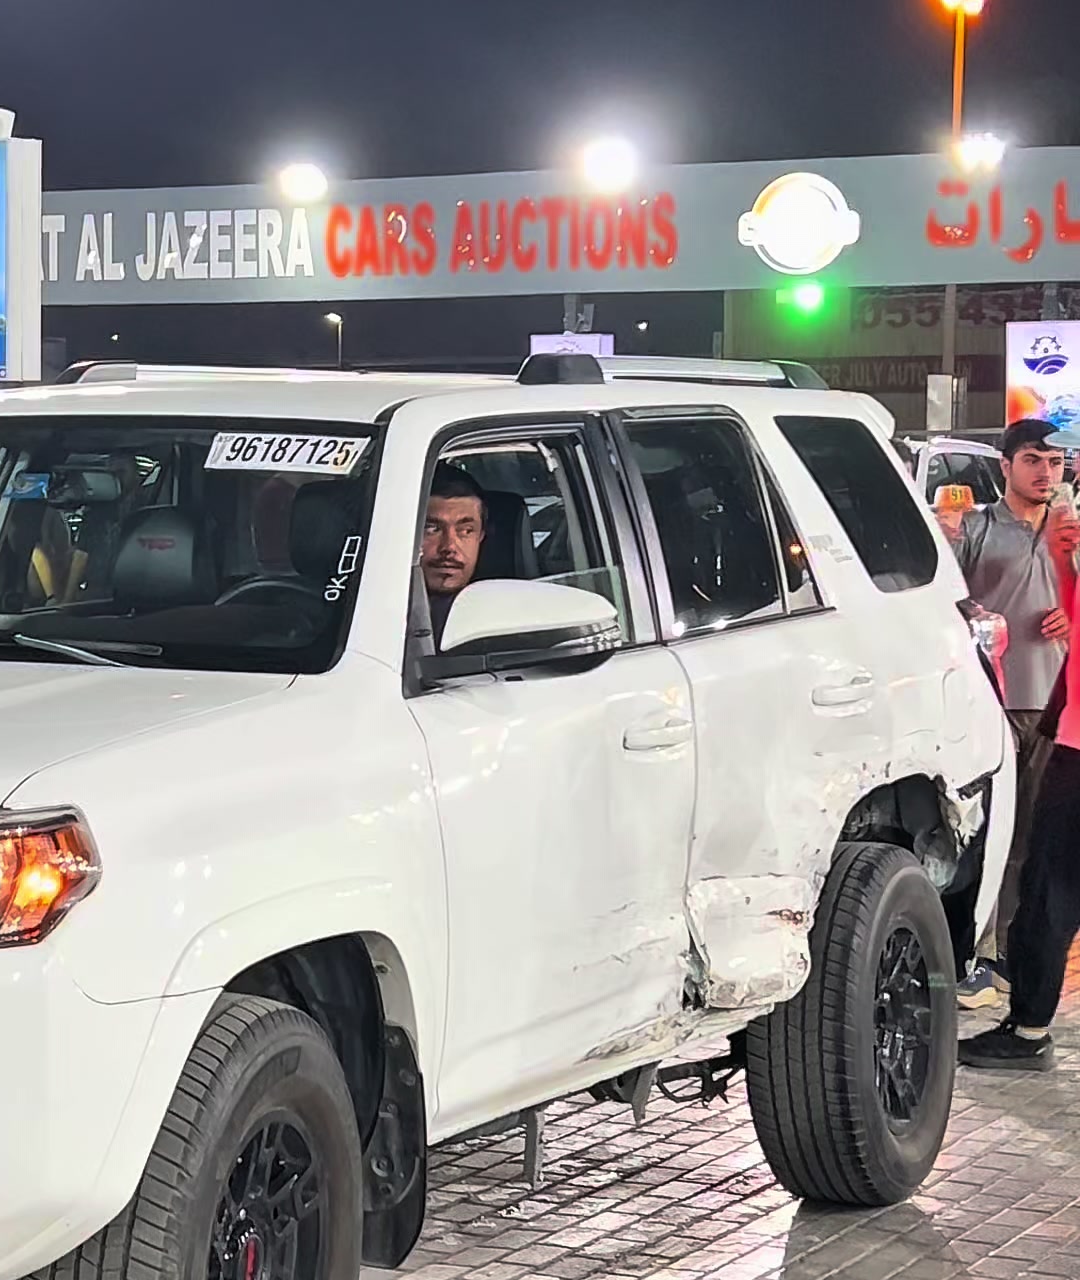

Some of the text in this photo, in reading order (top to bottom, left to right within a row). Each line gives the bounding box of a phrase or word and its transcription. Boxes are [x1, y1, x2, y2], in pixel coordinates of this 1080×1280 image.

[75, 212, 125, 282] AL
[135, 207, 314, 281] JAZEERA
[324, 201, 437, 278] CARS
[449, 191, 678, 275] AUCTIONS
[225, 436, 355, 466] 96187125
[324, 574, 349, 602] OK
